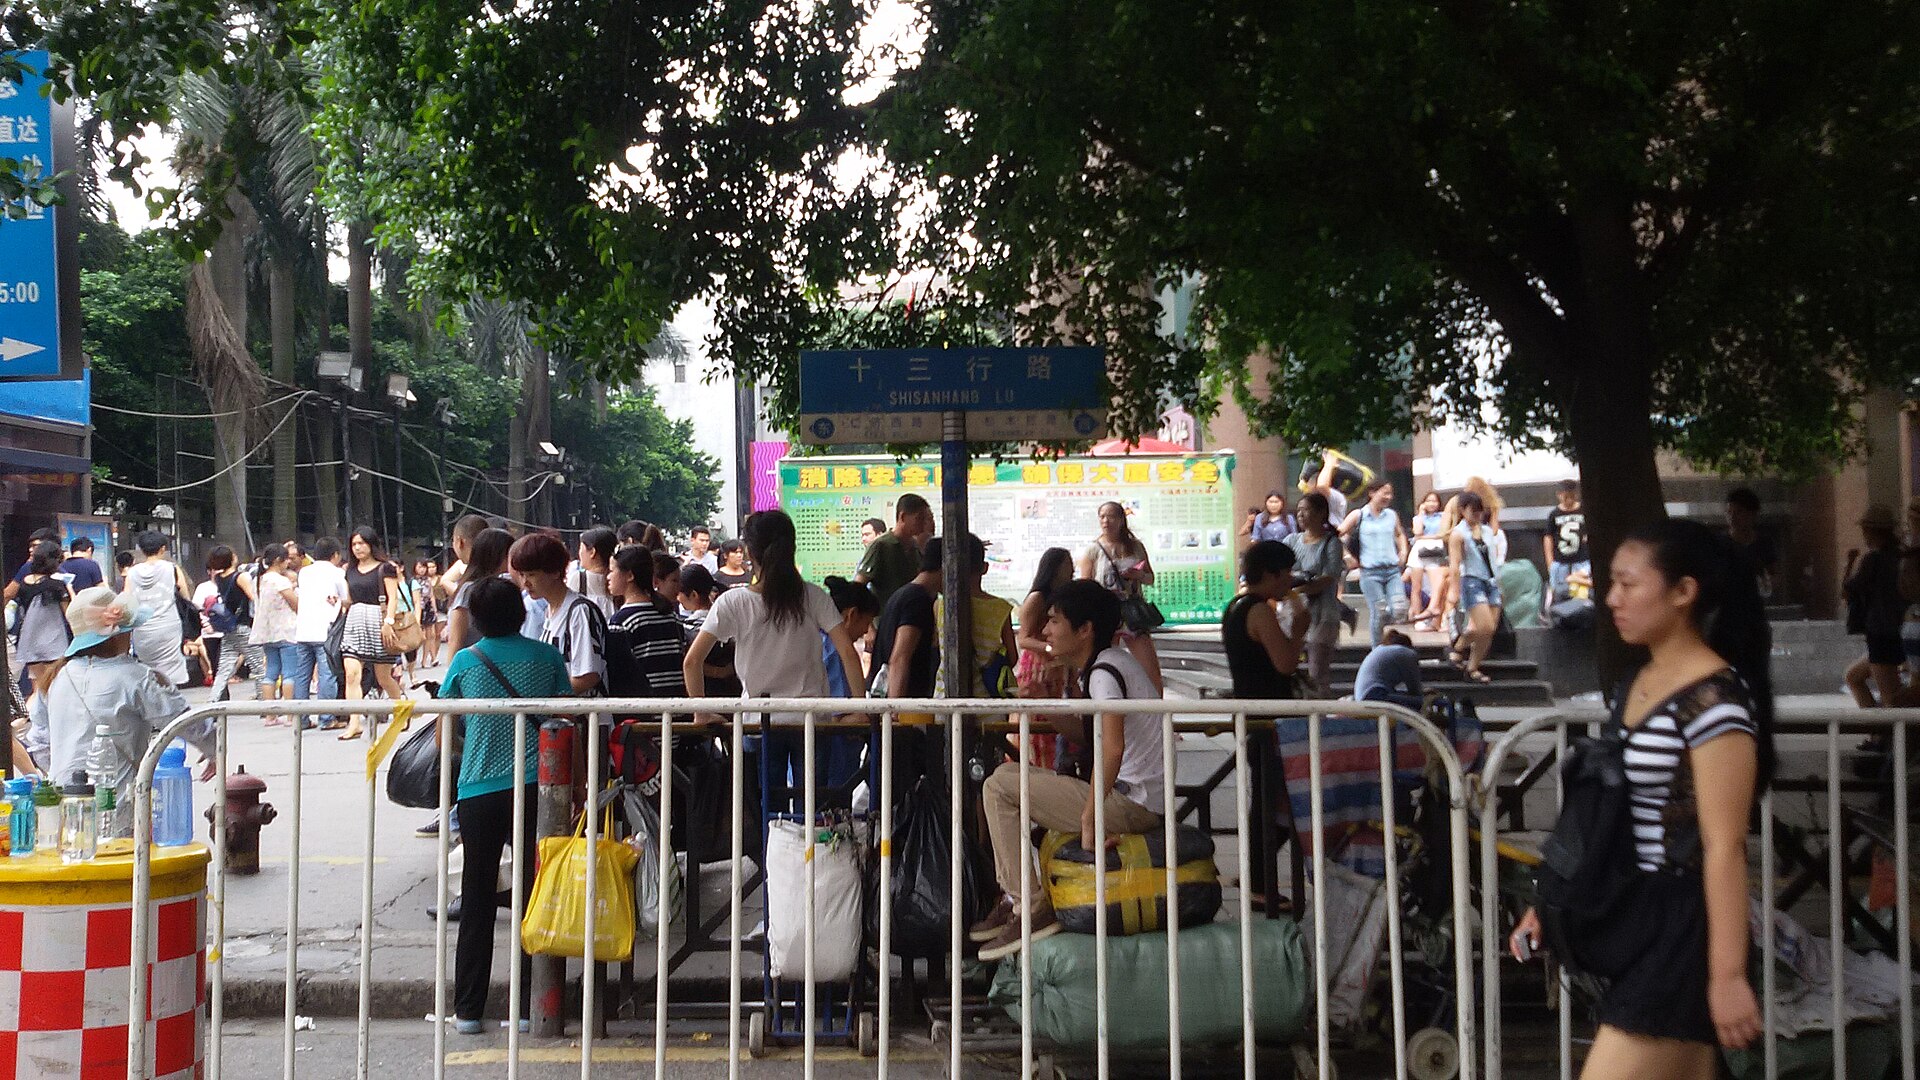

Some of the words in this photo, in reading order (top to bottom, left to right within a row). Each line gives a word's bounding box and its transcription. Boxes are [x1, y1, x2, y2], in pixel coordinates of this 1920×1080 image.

[848, 354, 1052, 384] 十三行路
[889, 389, 979, 407] SHISANHANG
[995, 388, 1014, 404] LU
[799, 465, 996, 489] 消除安全患
[1021, 461, 1220, 485] 确保大厦安全
